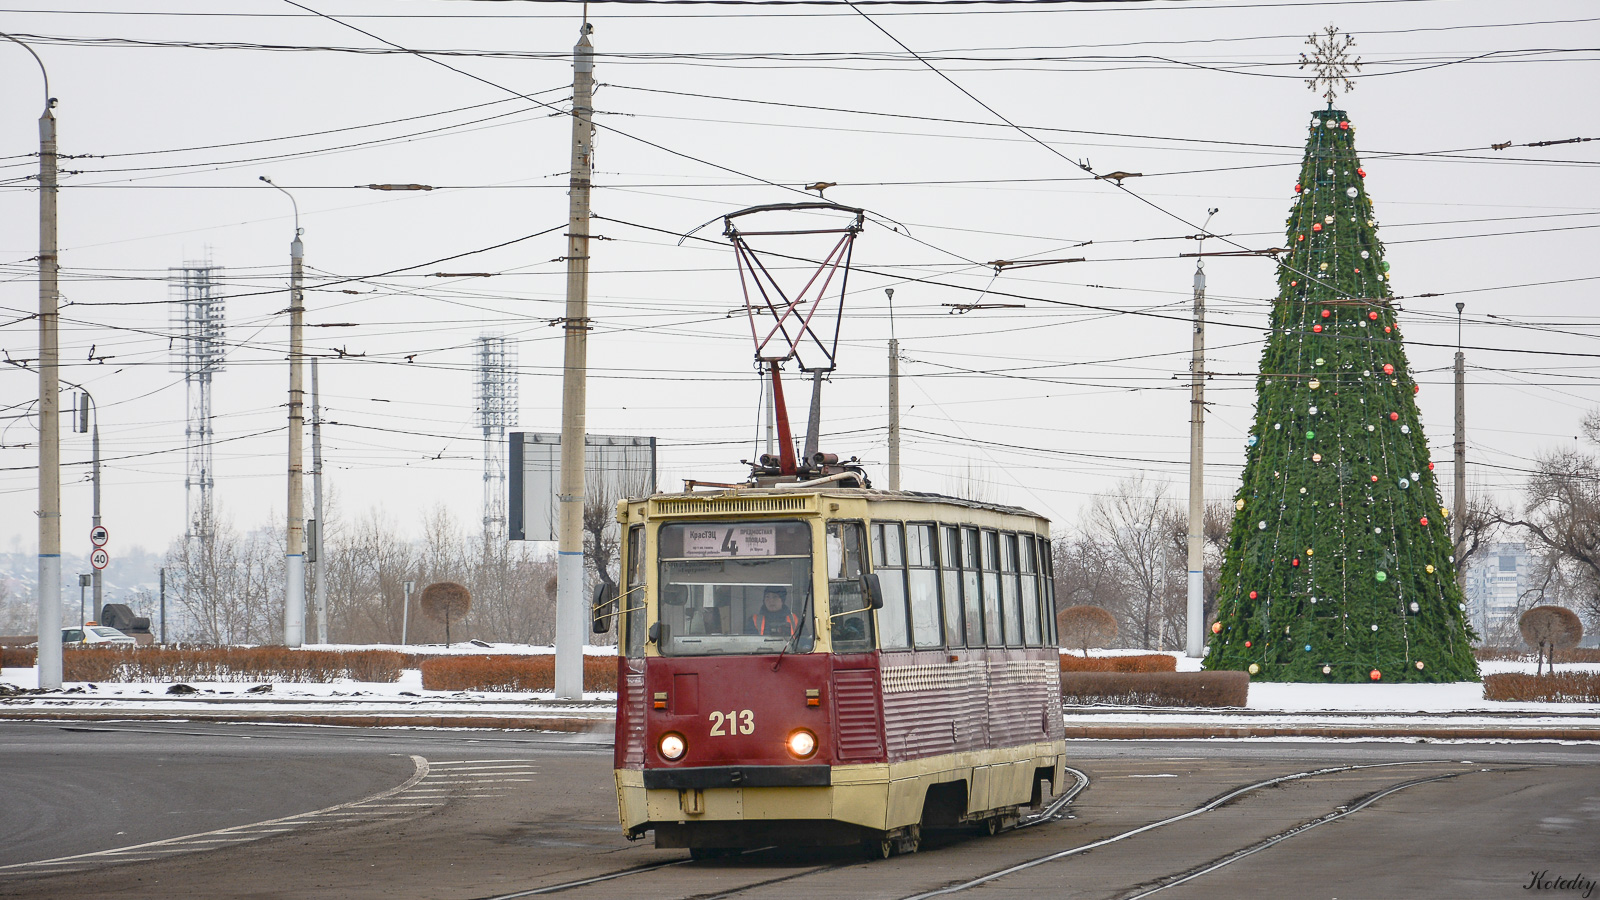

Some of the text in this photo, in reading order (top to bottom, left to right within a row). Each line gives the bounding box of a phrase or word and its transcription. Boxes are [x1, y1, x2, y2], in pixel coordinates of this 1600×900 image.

[689, 530, 716, 541] КрасТЭЦ
[745, 537, 767, 545] ПЛОЩАДЬ
[721, 528, 739, 556] 4
[94, 555, 106, 564] 40
[709, 709, 755, 737] 213
